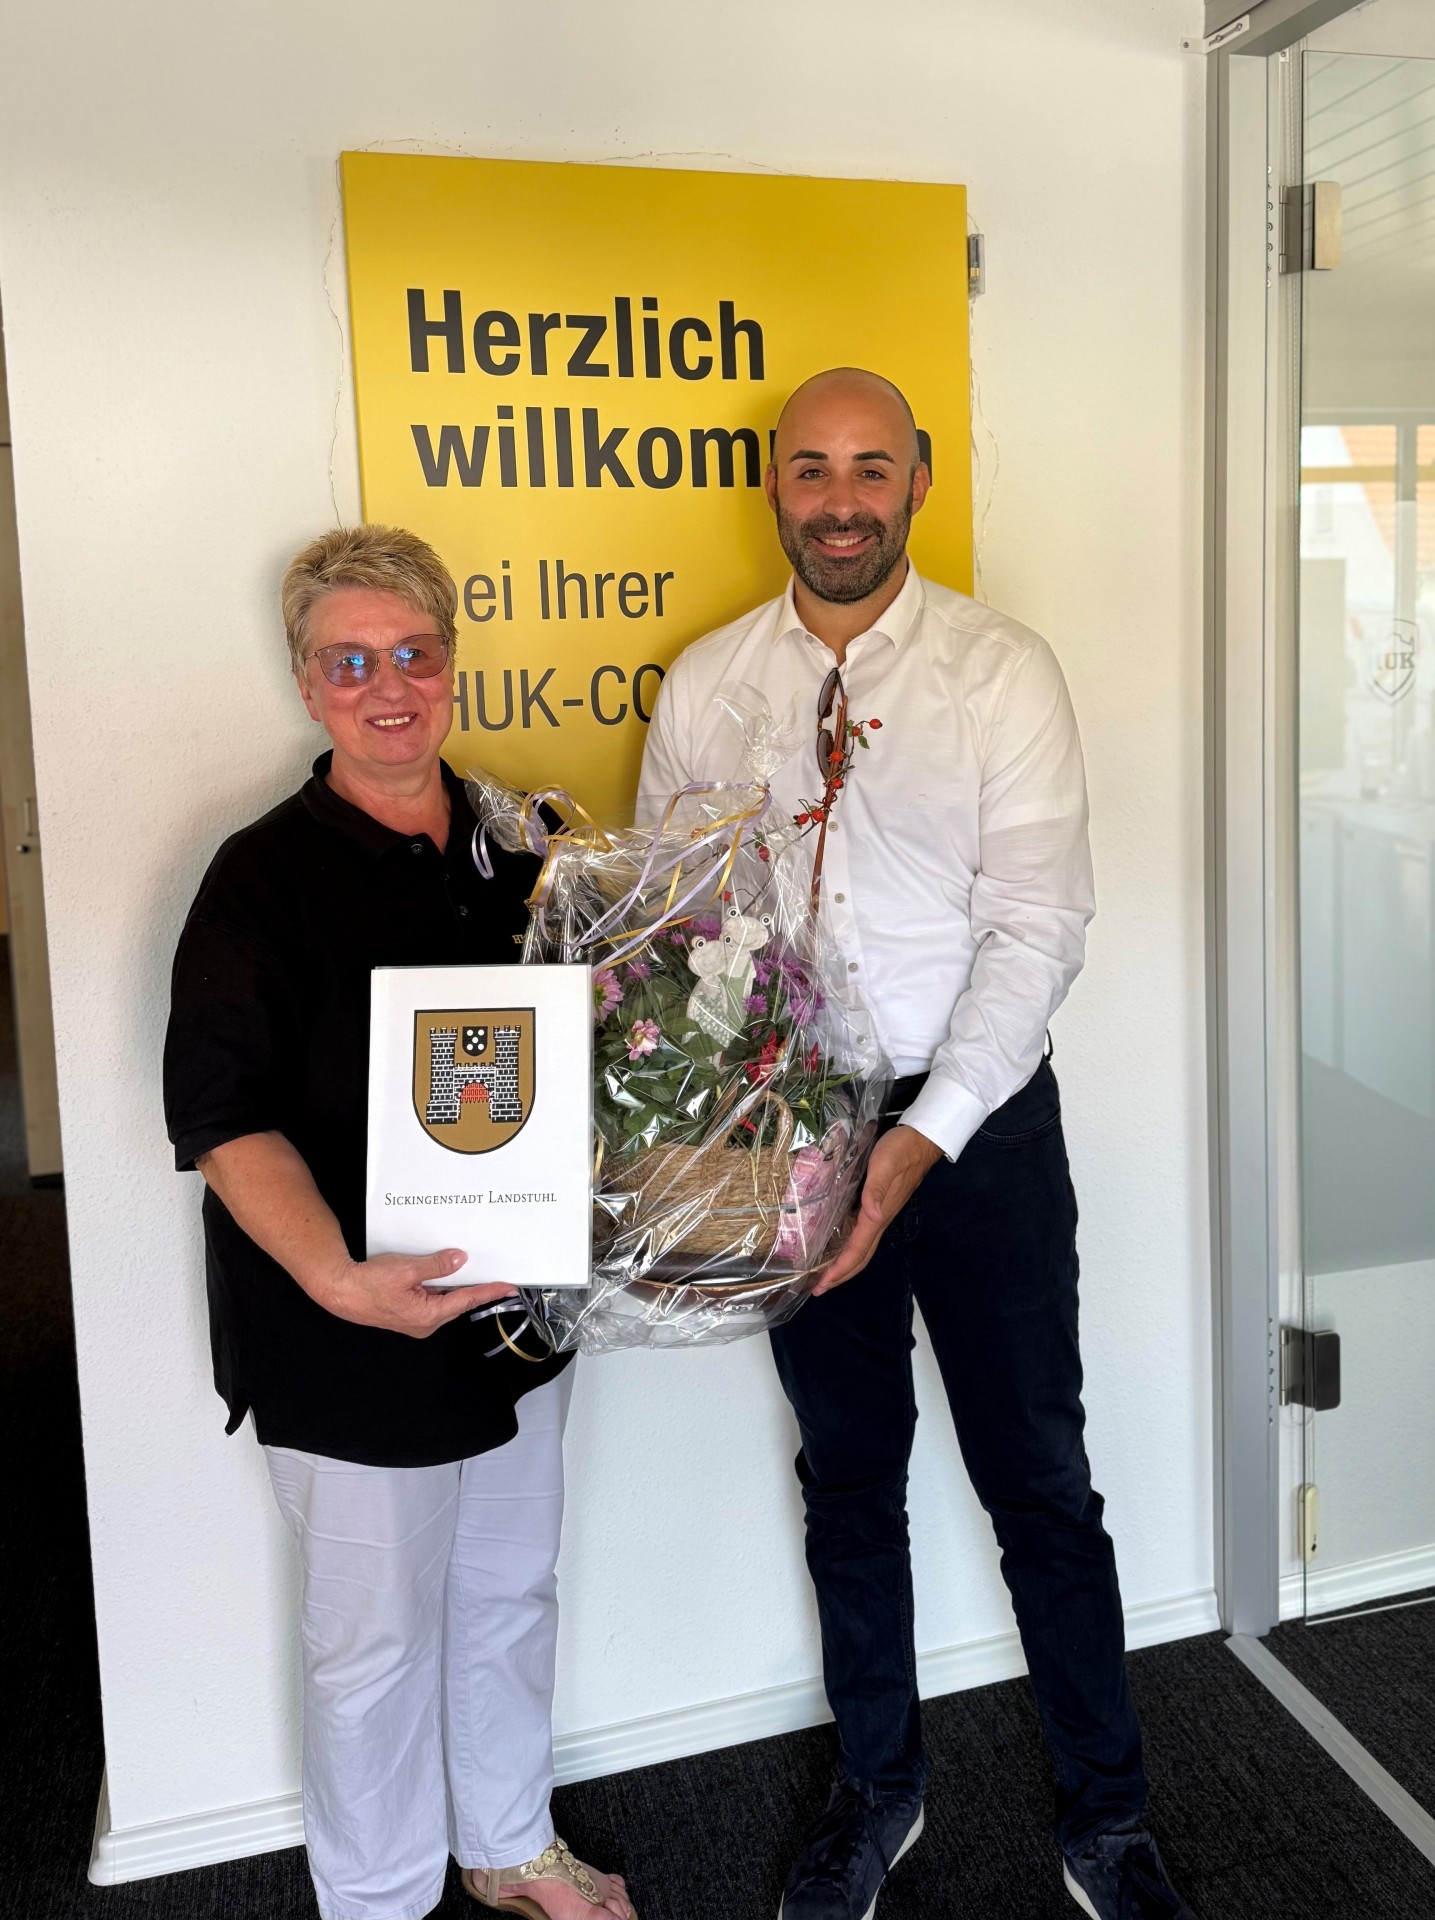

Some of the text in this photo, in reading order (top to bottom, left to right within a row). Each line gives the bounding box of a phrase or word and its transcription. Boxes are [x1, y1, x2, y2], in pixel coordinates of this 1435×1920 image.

[406, 288, 765, 381] Herzlich
[411, 405, 933, 488] willkom
[453, 559, 675, 622] ei Ihrer
